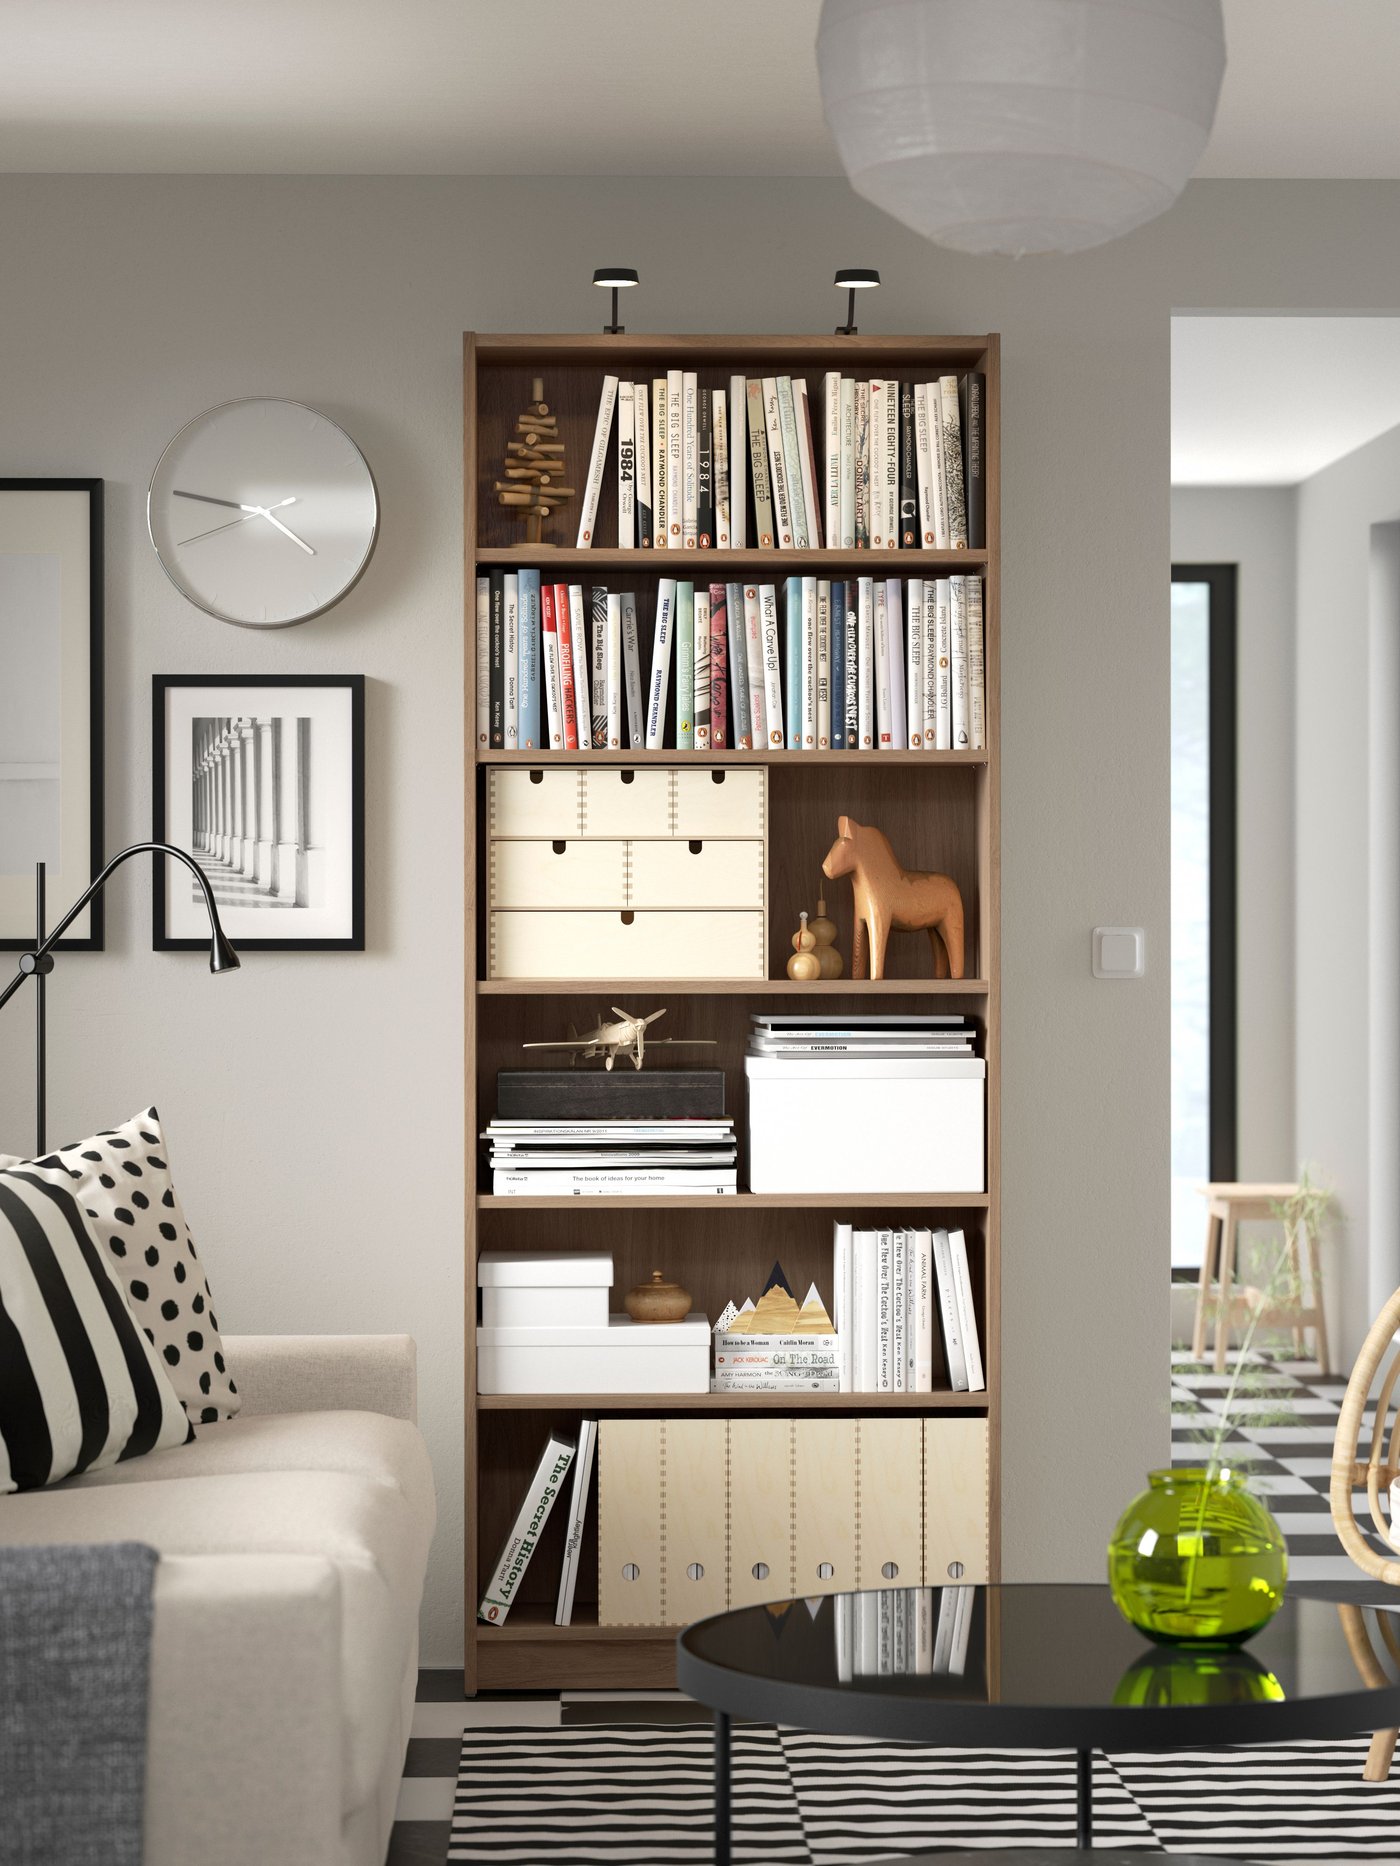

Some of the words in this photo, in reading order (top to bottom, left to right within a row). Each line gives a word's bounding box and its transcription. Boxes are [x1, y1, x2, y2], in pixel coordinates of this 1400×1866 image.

[671, 393, 679, 408] THE
[686, 388, 694, 404] One
[917, 395, 925, 412] THE
[671, 413, 679, 428] BIG
[686, 407, 694, 438] Hundred
[918, 413, 926, 427] BIG
[671, 434, 679, 459] SLEEP
[686, 441, 694, 458] Years
[751, 429, 760, 447] THE
[919, 429, 927, 452] SLEEP
[621, 438, 633, 481] 1984
[686, 461, 694, 470] of
[752, 452, 762, 467] BIG
[686, 473, 694, 502] Solitude
[754, 472, 764, 502] SLEEP
[764, 596, 774, 617] What
[912, 606, 920, 623] THE
[626, 607, 634, 635] Carrie's
[912, 626, 920, 639] BIG
[766, 629, 776, 654] Carve
[561, 644, 571, 685] PROFILING
[767, 657, 777, 671] Up!
[912, 642, 920, 665] SLEEP
[653, 670, 662, 701] RAYMOND
[680, 675, 691, 692] Fairy
[564, 688, 574, 724] HACKERS
[681, 694, 691, 711] Tales
[650, 703, 659, 736] CHANDLER
[773, 1354, 786, 1364] On
[790, 1354, 808, 1364] The
[811, 1354, 834, 1364] Road
[549, 1454, 571, 1484] The
[526, 1487, 556, 1537] Secret
[505, 1538, 521, 1562] Donna
[499, 1539, 534, 1600] History
